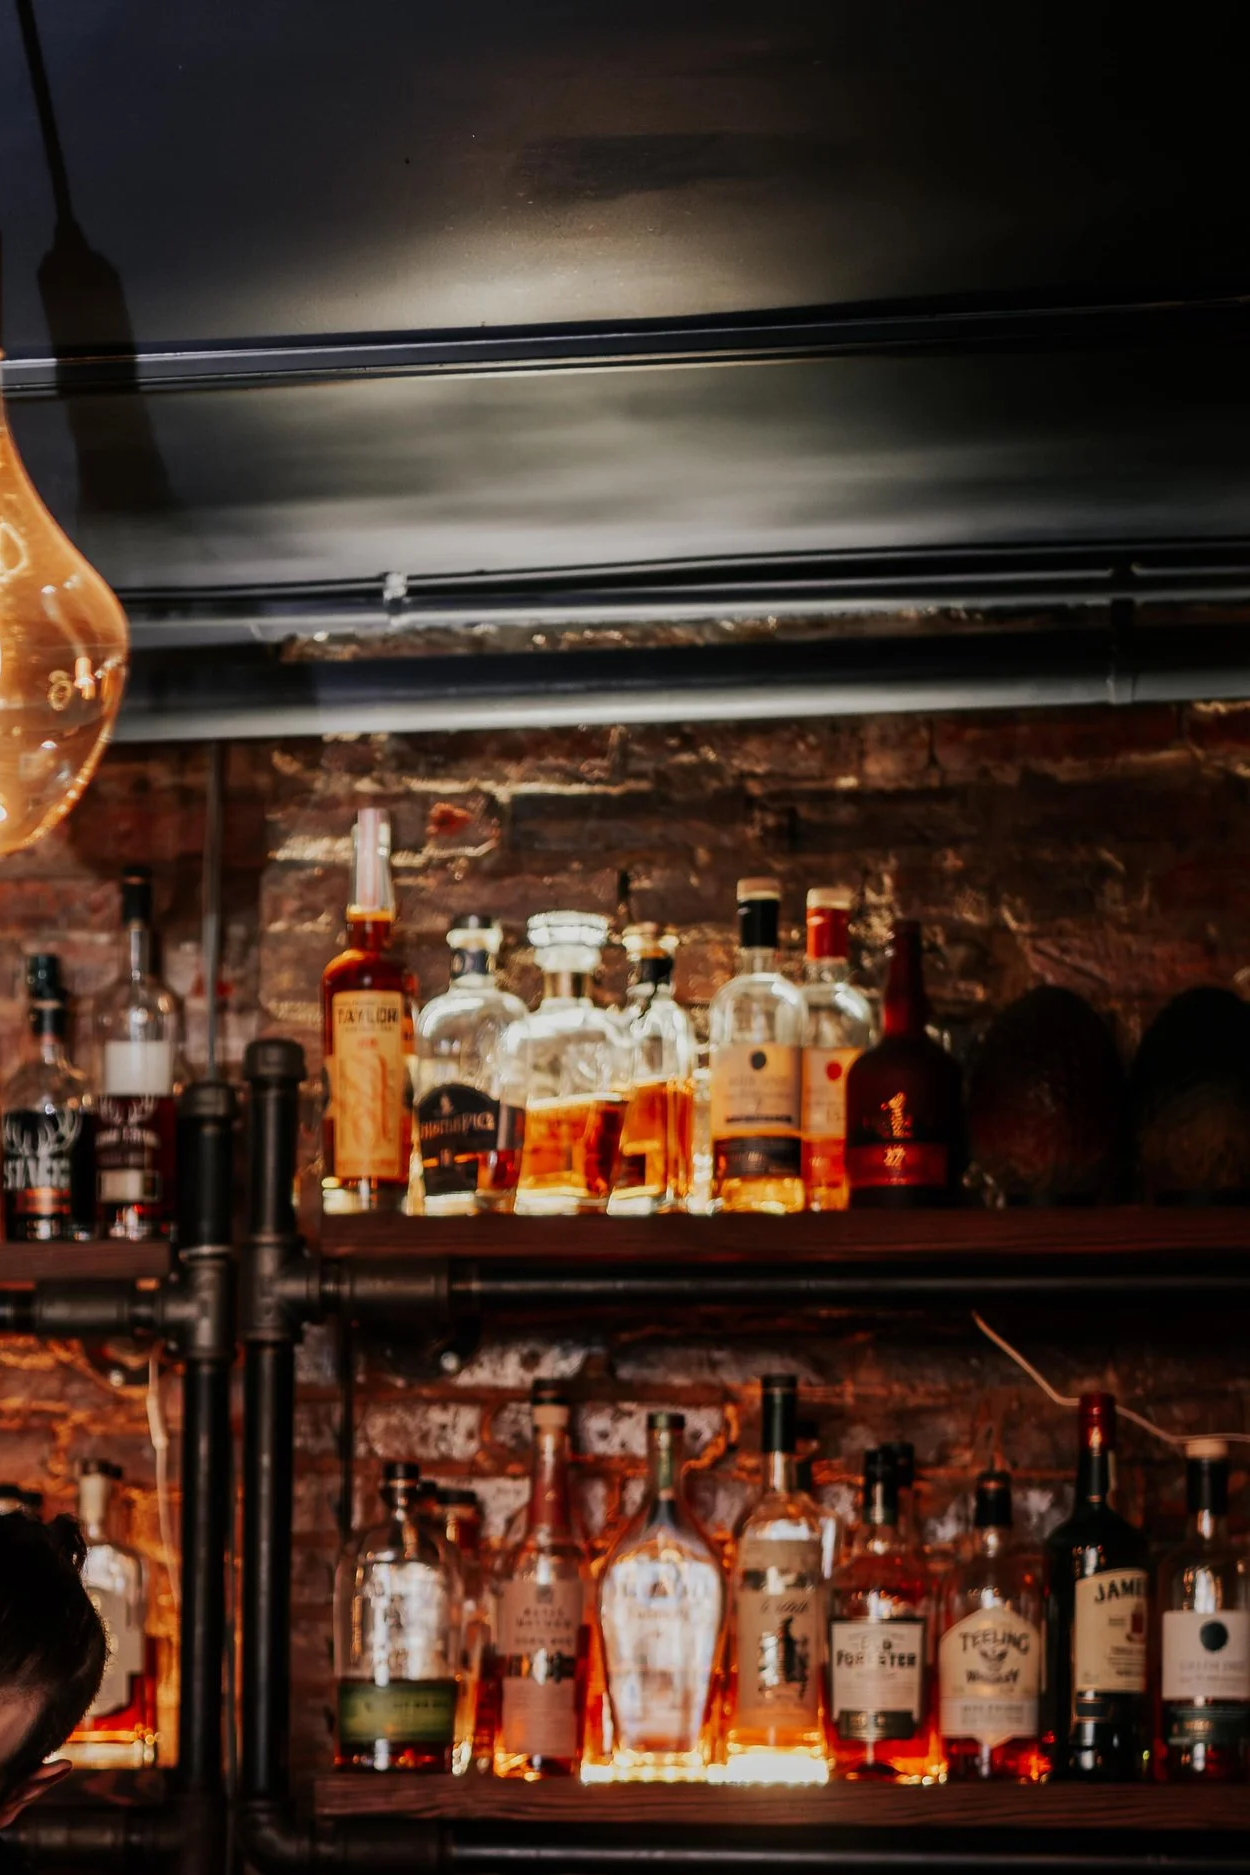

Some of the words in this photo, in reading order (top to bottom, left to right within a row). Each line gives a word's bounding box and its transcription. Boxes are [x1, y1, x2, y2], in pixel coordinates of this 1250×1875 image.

[337, 1006, 399, 1025] TAYLOR
[861, 1636, 892, 1651] OD
[959, 1629, 1031, 1656] TEELING
[836, 1650, 916, 1668] FORSTER
